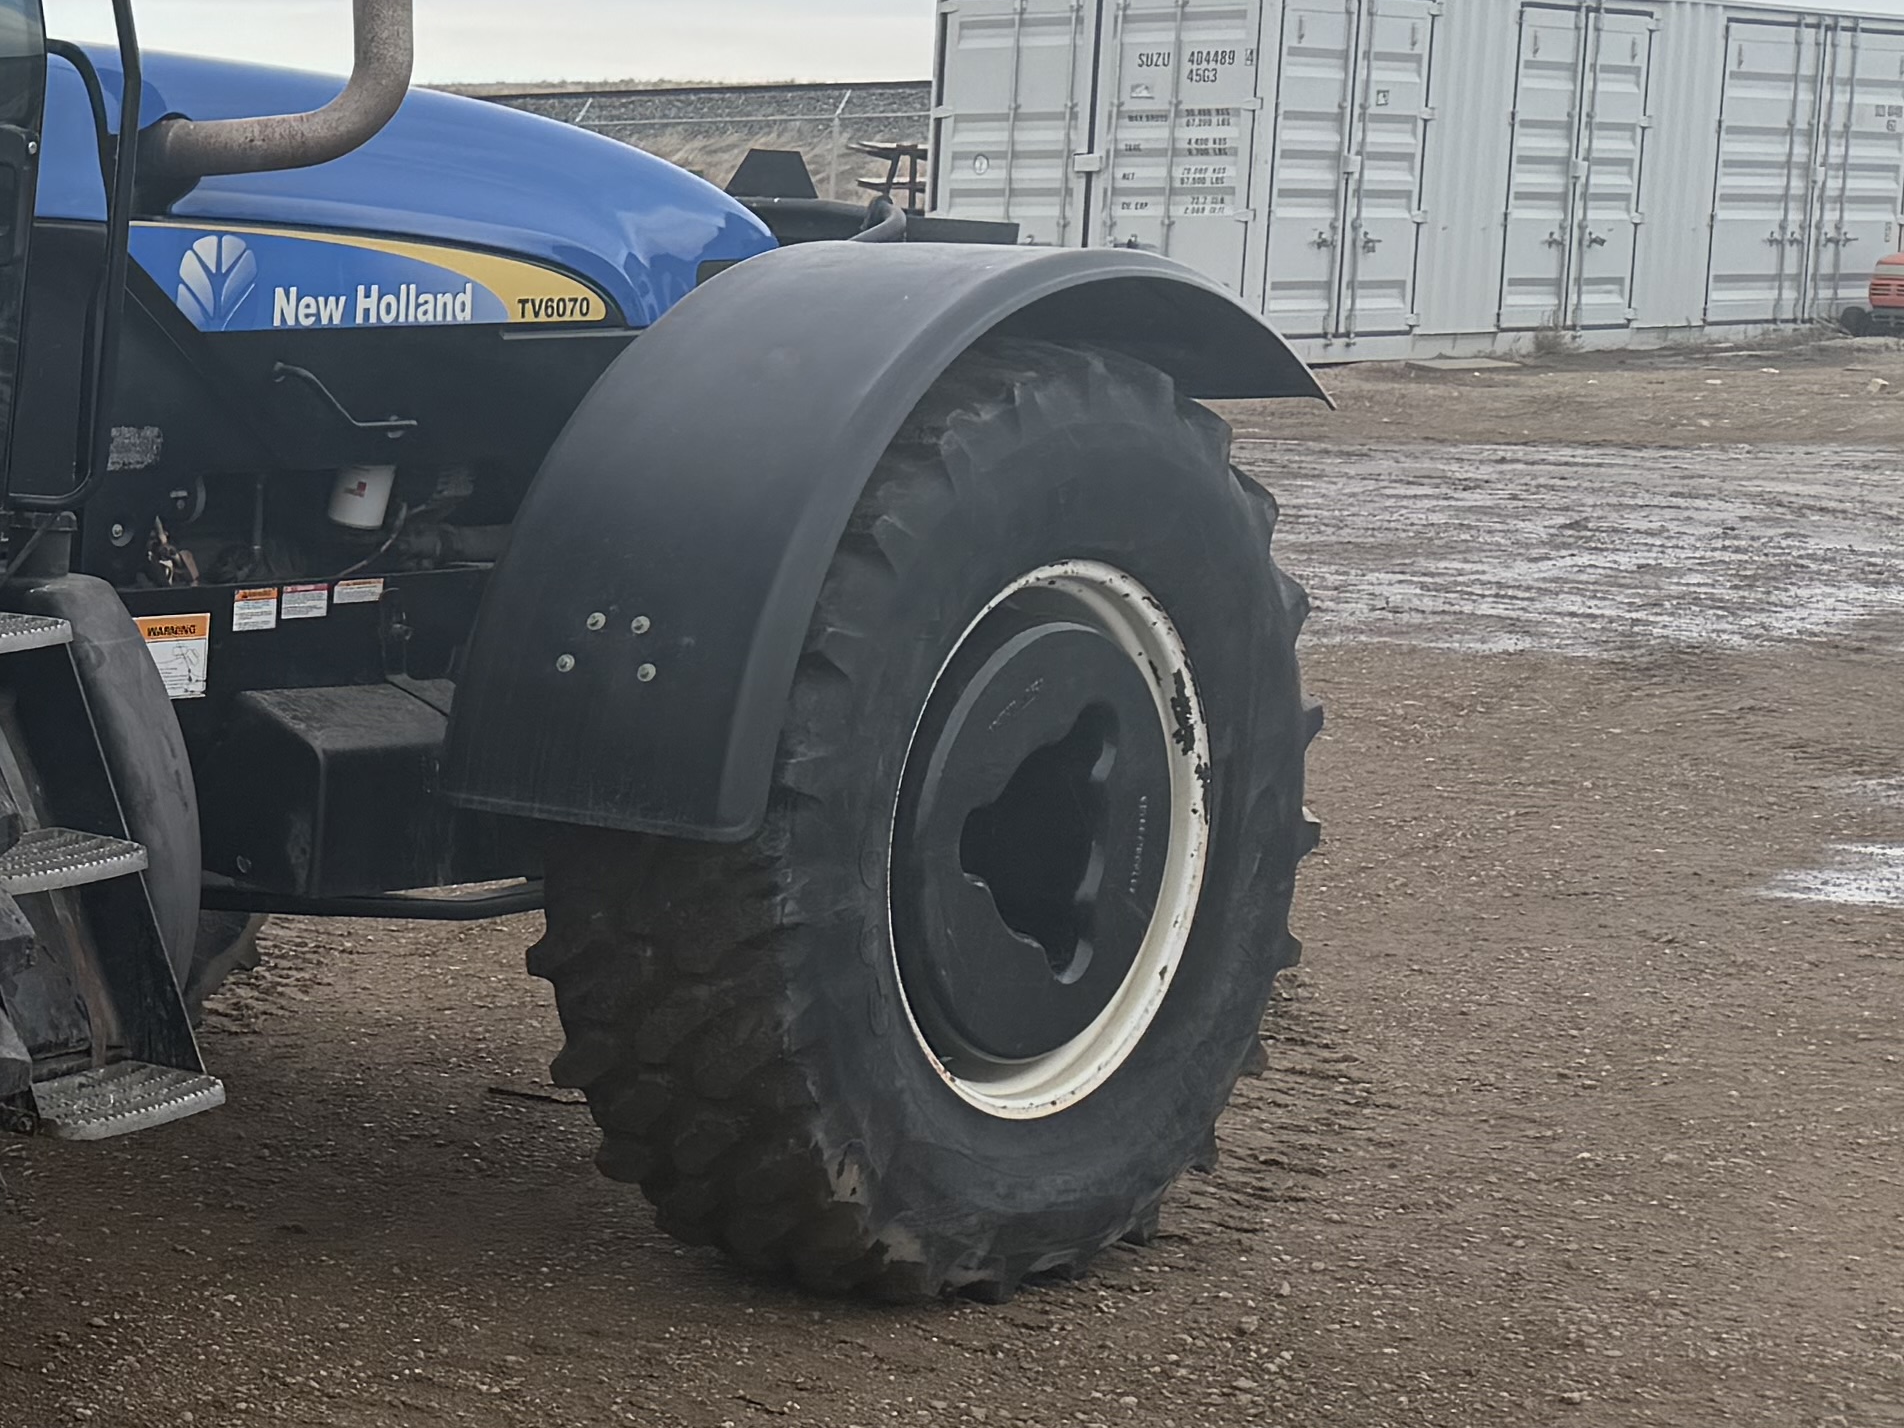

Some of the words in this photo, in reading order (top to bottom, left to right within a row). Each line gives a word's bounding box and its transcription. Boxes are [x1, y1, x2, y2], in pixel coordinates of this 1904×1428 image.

[1137, 52, 1171, 68] SUZU
[1186, 68, 1218, 83] 45G3
[272, 286, 346, 327] New
[355, 282, 473, 325] Holland
[517, 296, 591, 319] TV6070
[146, 624, 198, 638] WARNING
